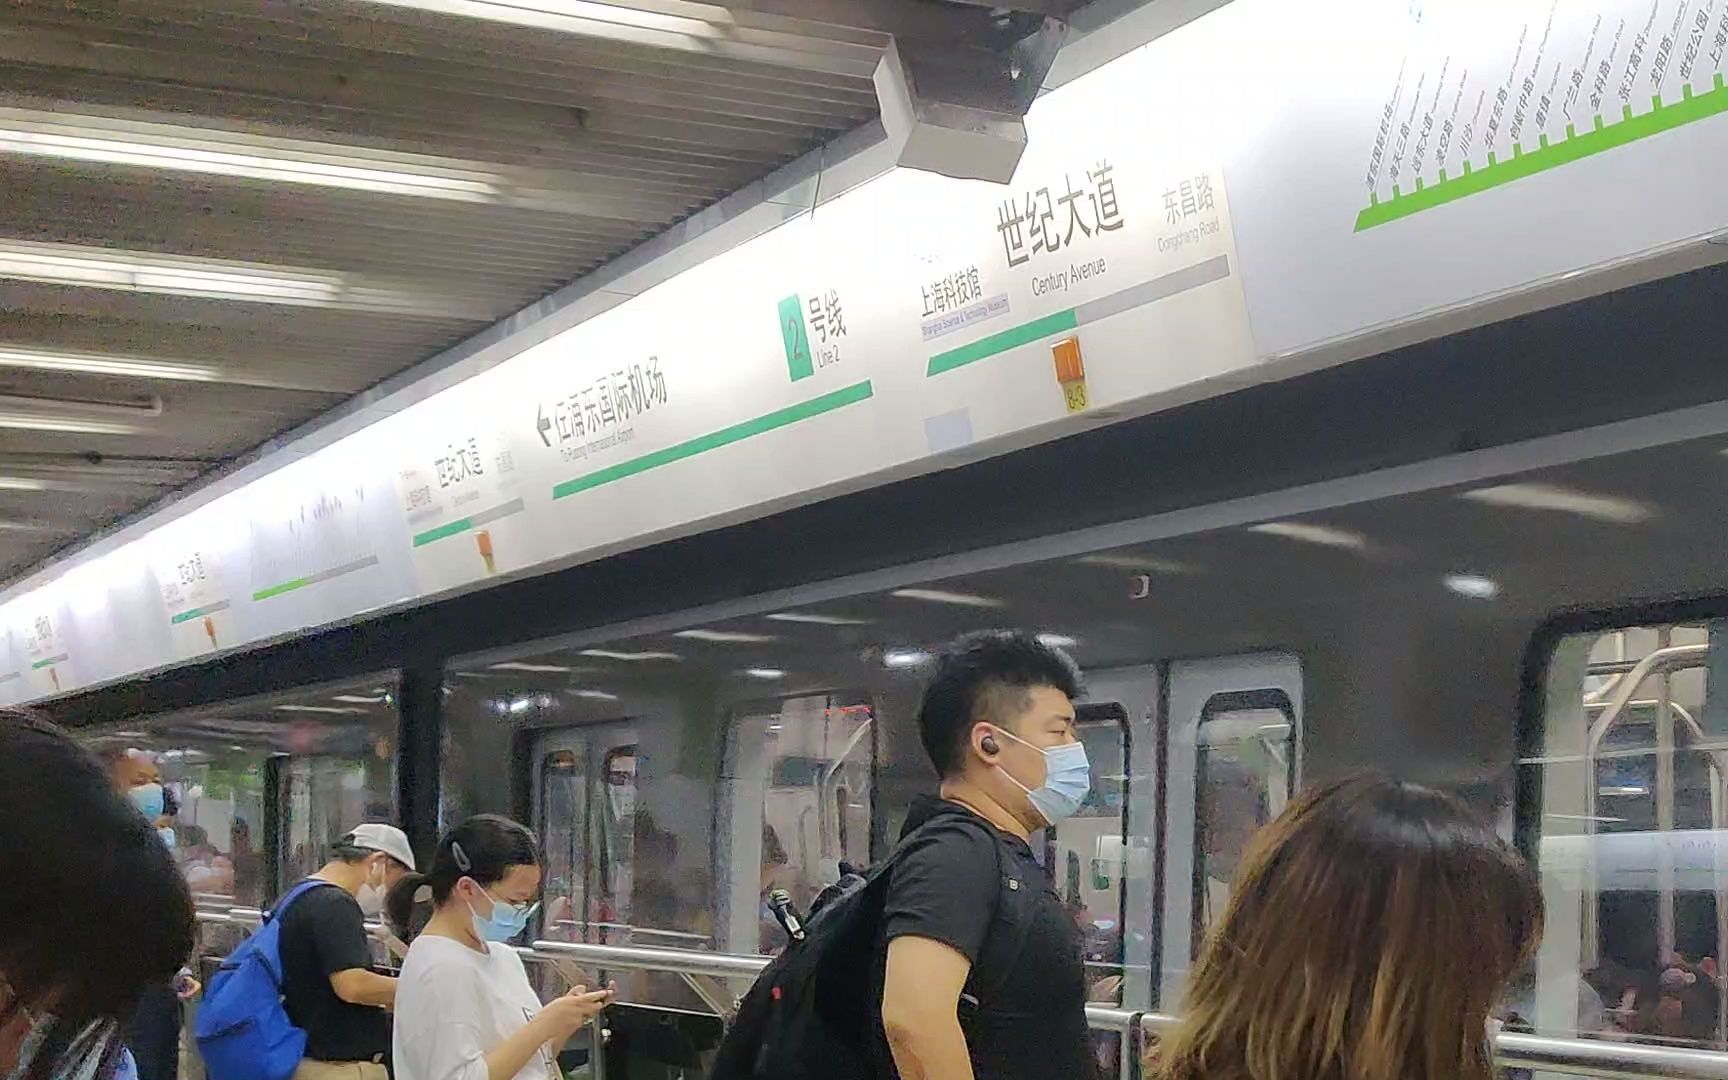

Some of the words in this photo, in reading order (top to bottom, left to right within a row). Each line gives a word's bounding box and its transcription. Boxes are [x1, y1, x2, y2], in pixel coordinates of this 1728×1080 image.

[997, 158, 1124, 267] 世纪大道
[1161, 172, 1216, 225] 东昌路
[1198, 215, 1221, 239] Road
[921, 265, 983, 318] 上海科技馆
[1031, 268, 1070, 297] Century
[1069, 257, 1107, 286] Avenue
[787, 315, 803, 361] 2
[808, 288, 847, 343] 号线
